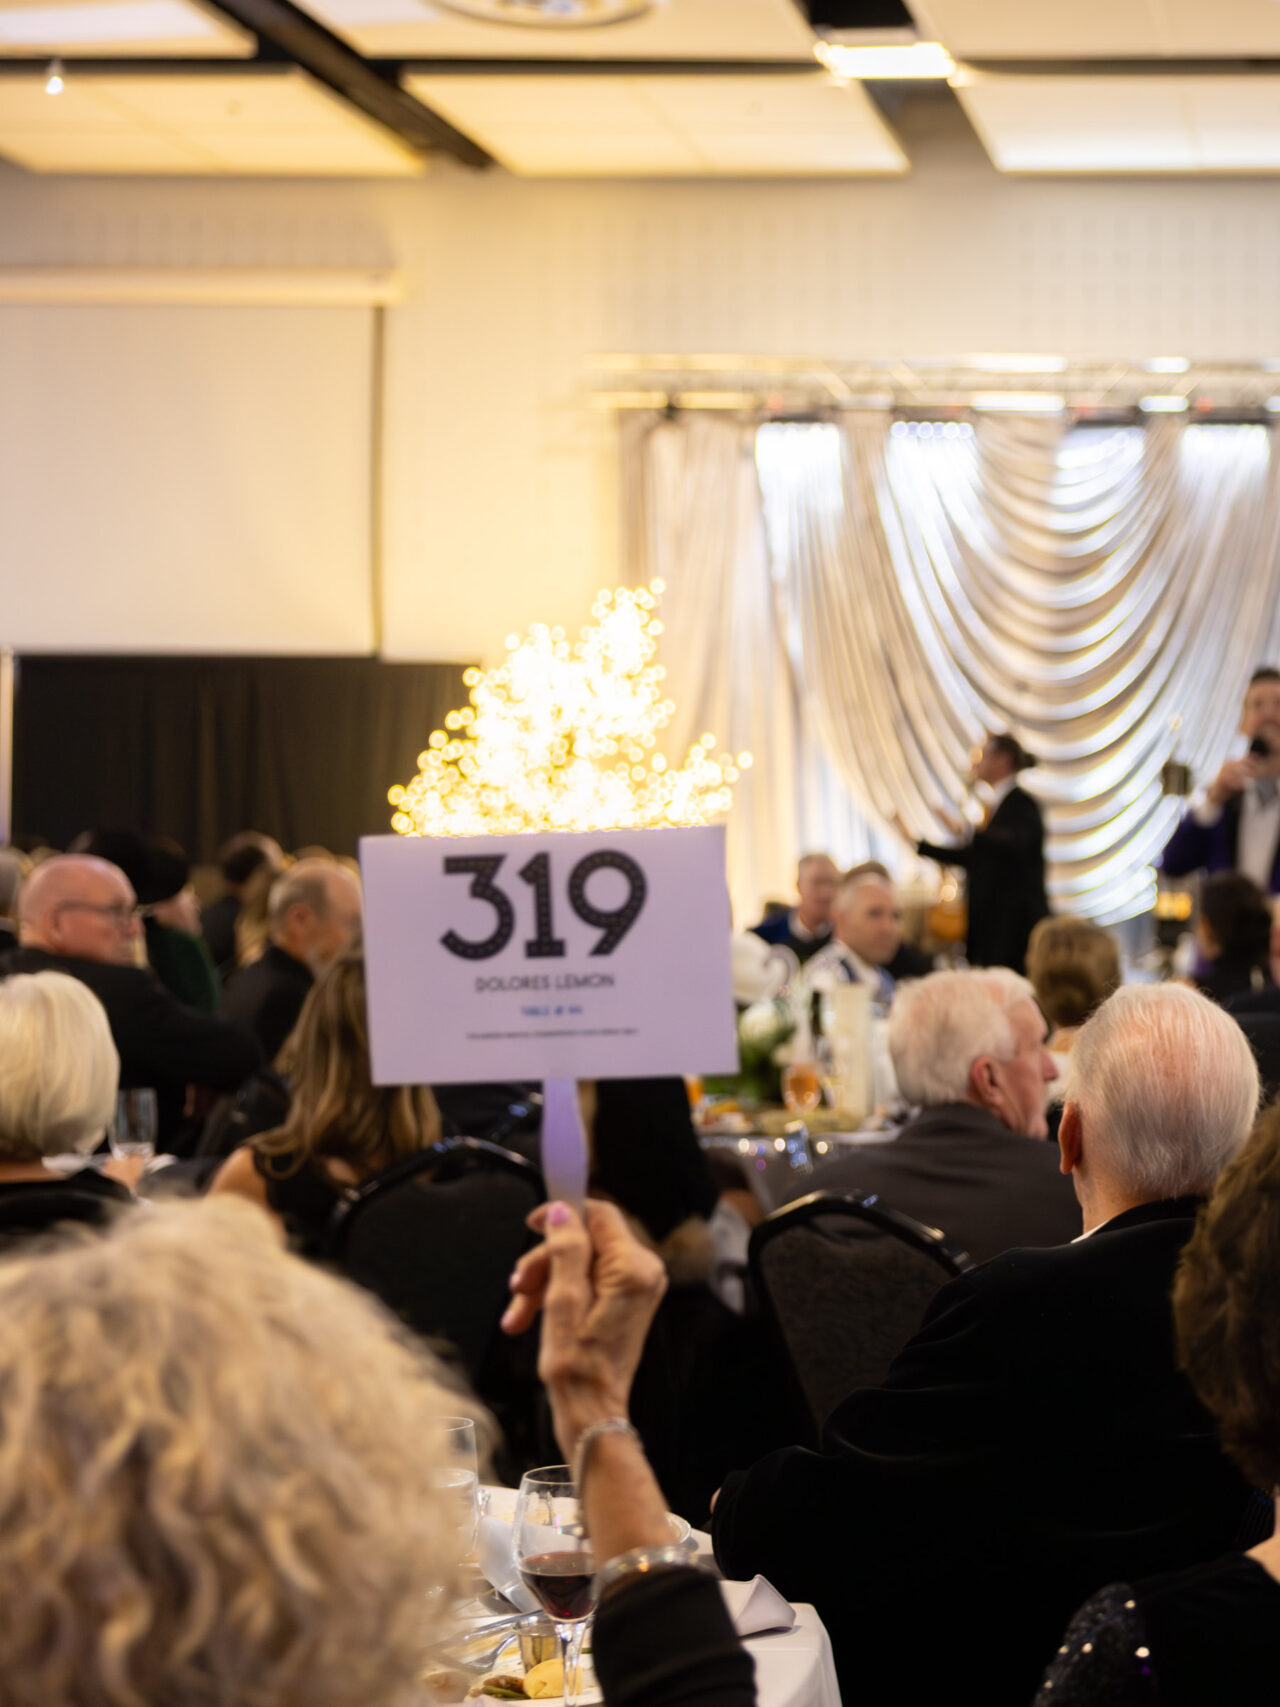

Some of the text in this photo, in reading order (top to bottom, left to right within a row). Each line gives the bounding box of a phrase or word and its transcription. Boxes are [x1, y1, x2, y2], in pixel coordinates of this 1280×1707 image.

[439, 849, 648, 962] 319
[474, 973, 616, 993] DOLORES LEMON
